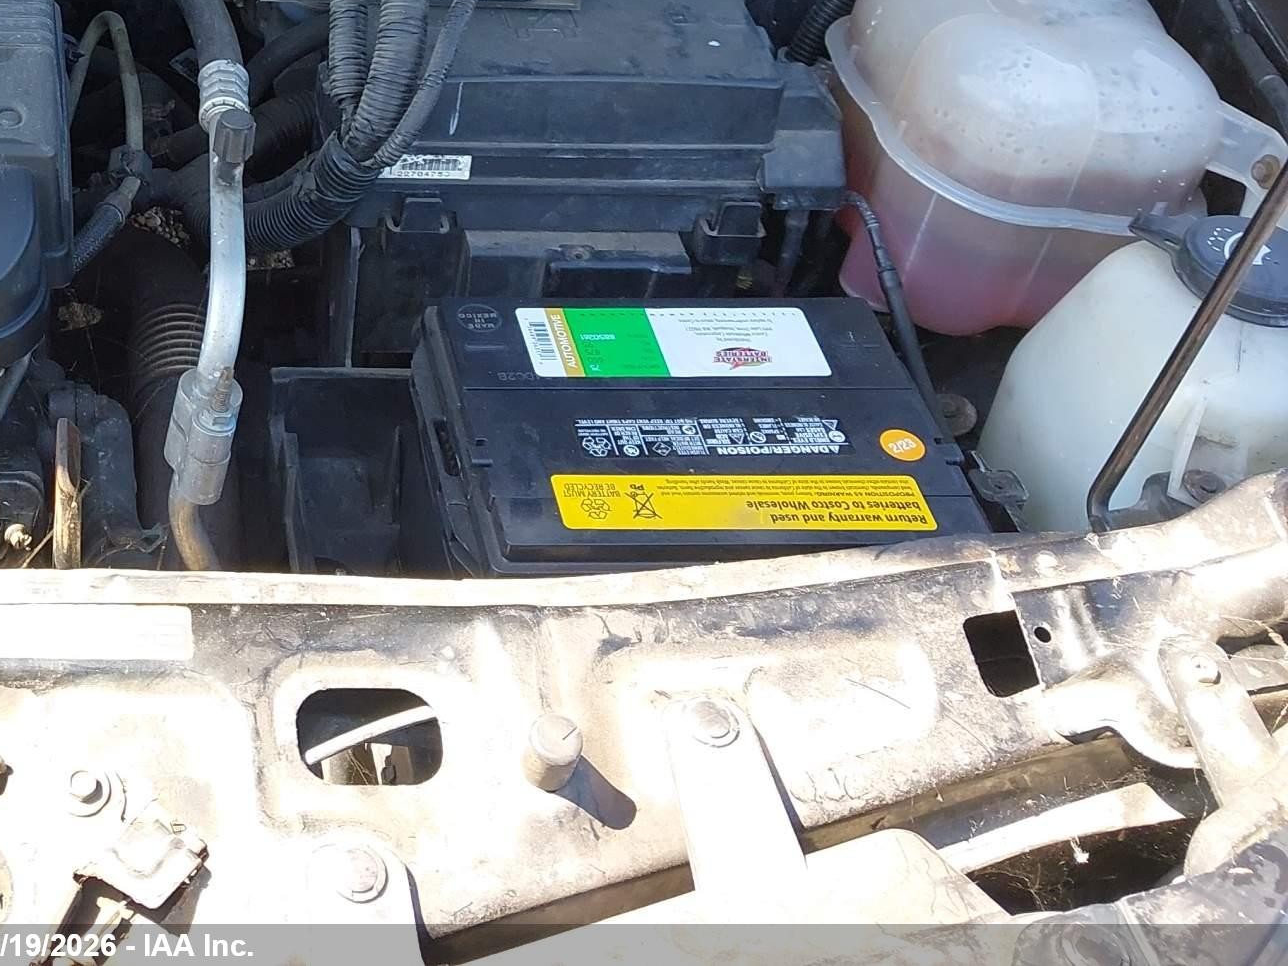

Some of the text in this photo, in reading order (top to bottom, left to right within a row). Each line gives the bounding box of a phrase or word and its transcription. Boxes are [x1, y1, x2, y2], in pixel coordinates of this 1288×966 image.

[551, 314, 578, 368] AUTOMOTIVE
[713, 356, 772, 364] INTERSTATE
[716, 445, 829, 454] DANGER/POISON
[564, 483, 603, 491] RECYCLED
[563, 490, 586, 498] MUST
[747, 500, 921, 511] batteries to Costco Wholesale
[770, 512, 928, 525] Return warranty and used
